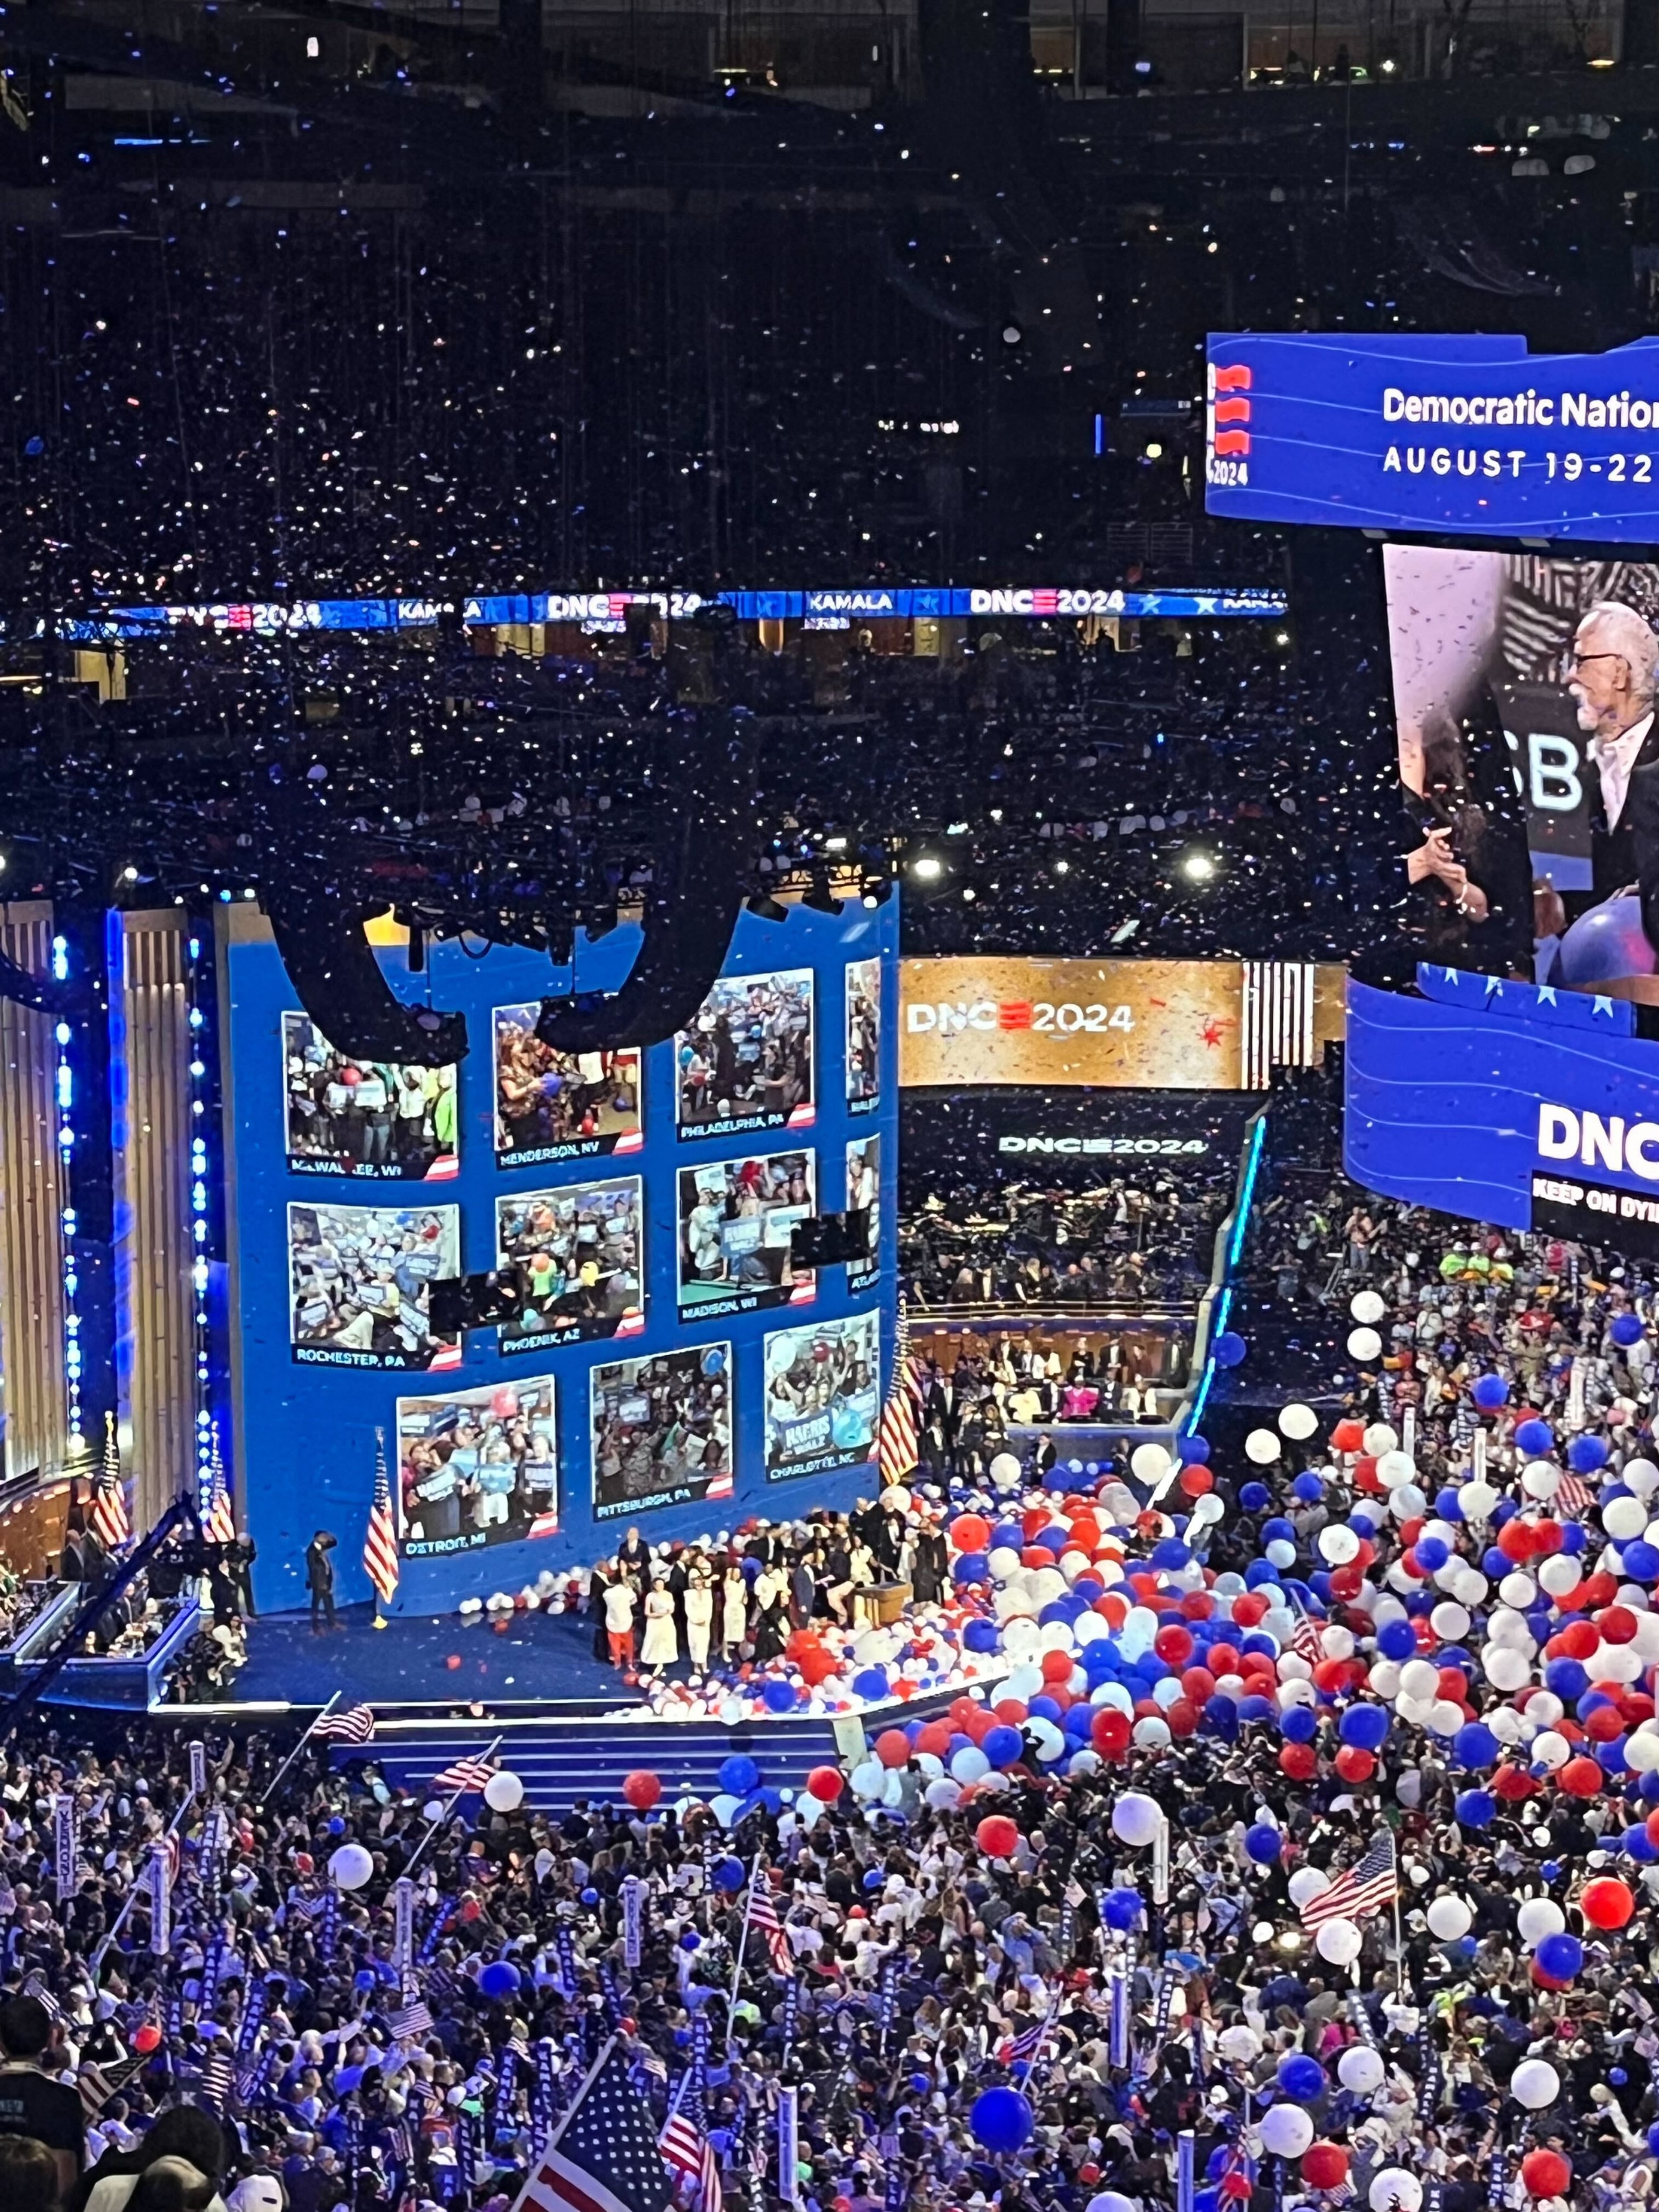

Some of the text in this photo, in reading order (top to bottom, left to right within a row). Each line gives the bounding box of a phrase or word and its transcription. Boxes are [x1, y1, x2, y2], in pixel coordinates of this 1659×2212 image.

[1384, 388, 1554, 426] Democratic
[1383, 447, 1652, 483] AUGUST 19-22
[810, 594, 893, 610] KAMALA
[582, 1141, 599, 1153] NV
[1533, 1178, 1584, 1206] KEEP
[1586, 1191, 1617, 1214] ON
[563, 1328, 581, 1341] AZ
[297, 1349, 406, 1367] ROCHESTER, PA
